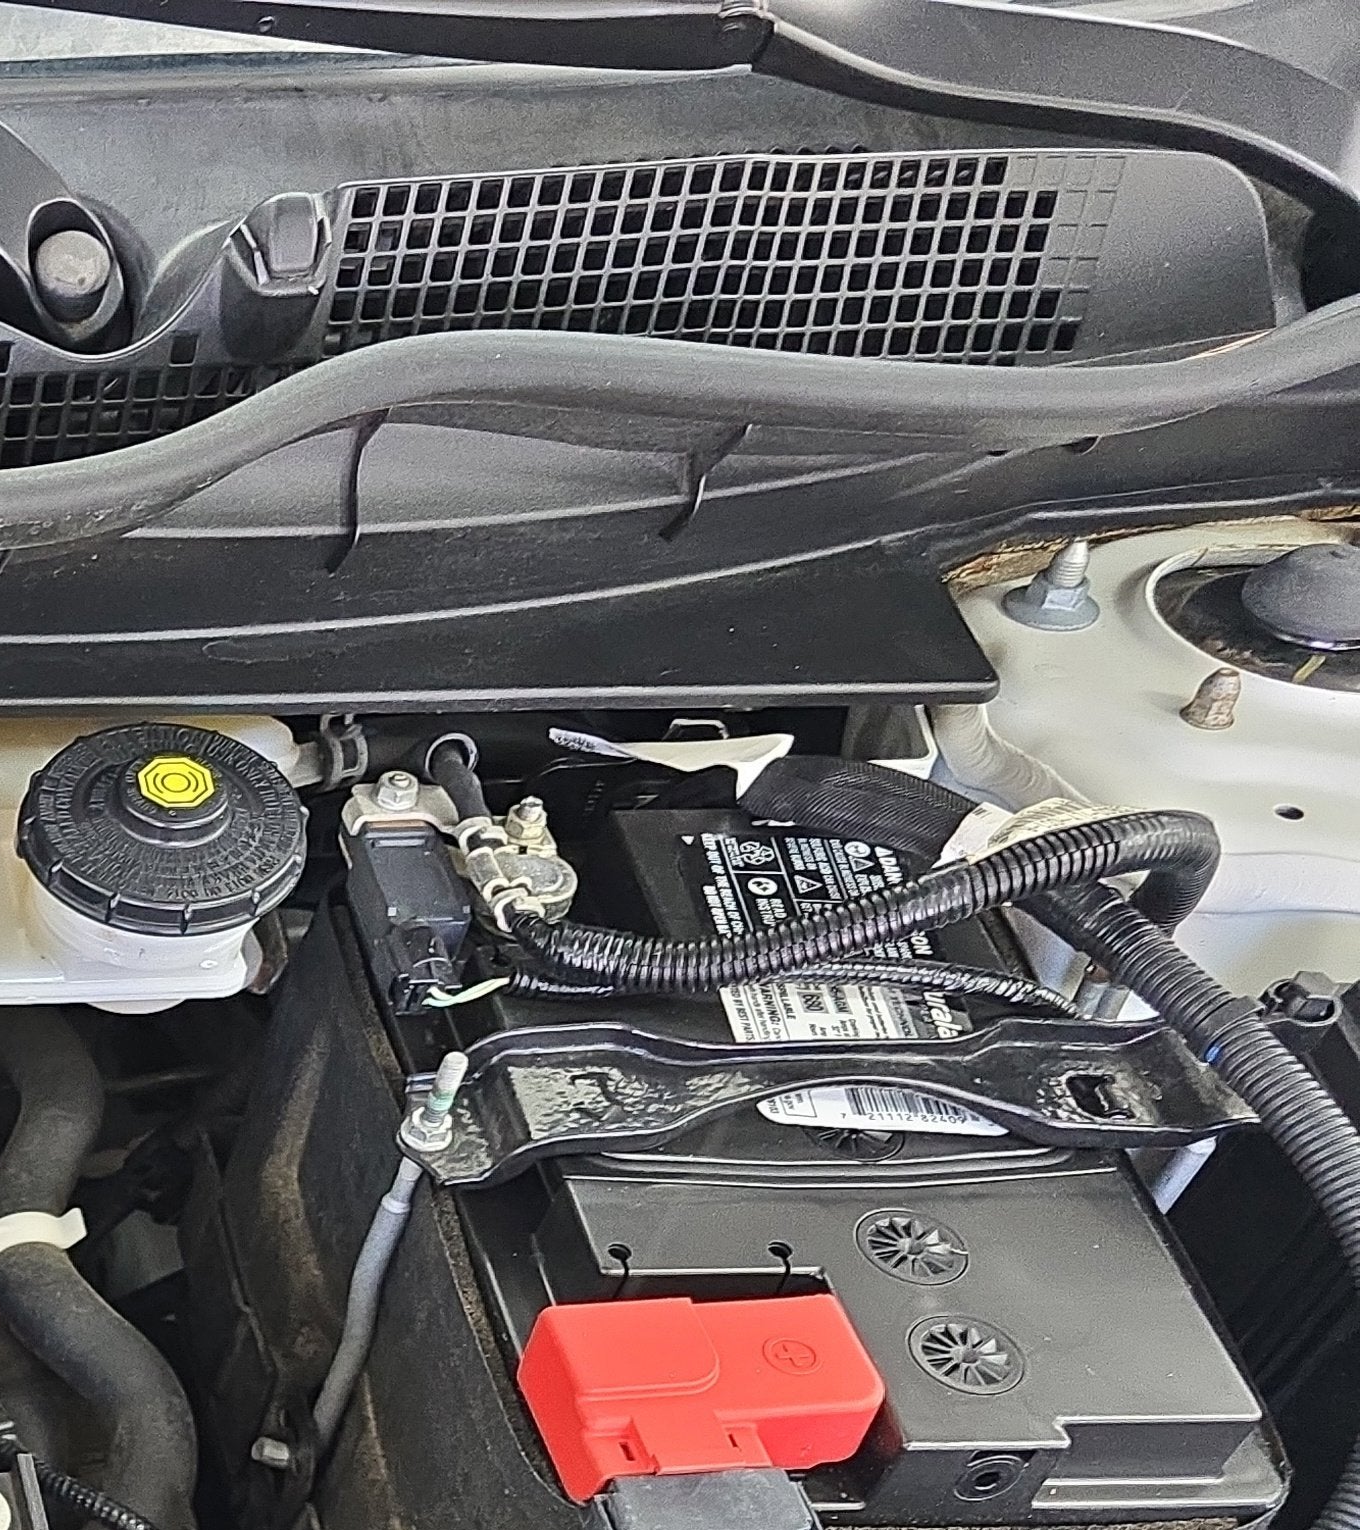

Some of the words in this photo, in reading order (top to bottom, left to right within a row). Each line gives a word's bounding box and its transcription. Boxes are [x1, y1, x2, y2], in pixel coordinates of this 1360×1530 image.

[700, 833, 717, 850] KEEP
[706, 851, 722, 864] OUT
[711, 865, 725, 874] OF
[714, 875, 730, 888] THE
[720, 888, 737, 910] REACH
[769, 898, 787, 918] READ
[727, 911, 741, 920] OF
[802, 994, 824, 1011] 680
[736, 1008, 749, 1021] BEST
[868, 1113, 914, 1121] 21112
